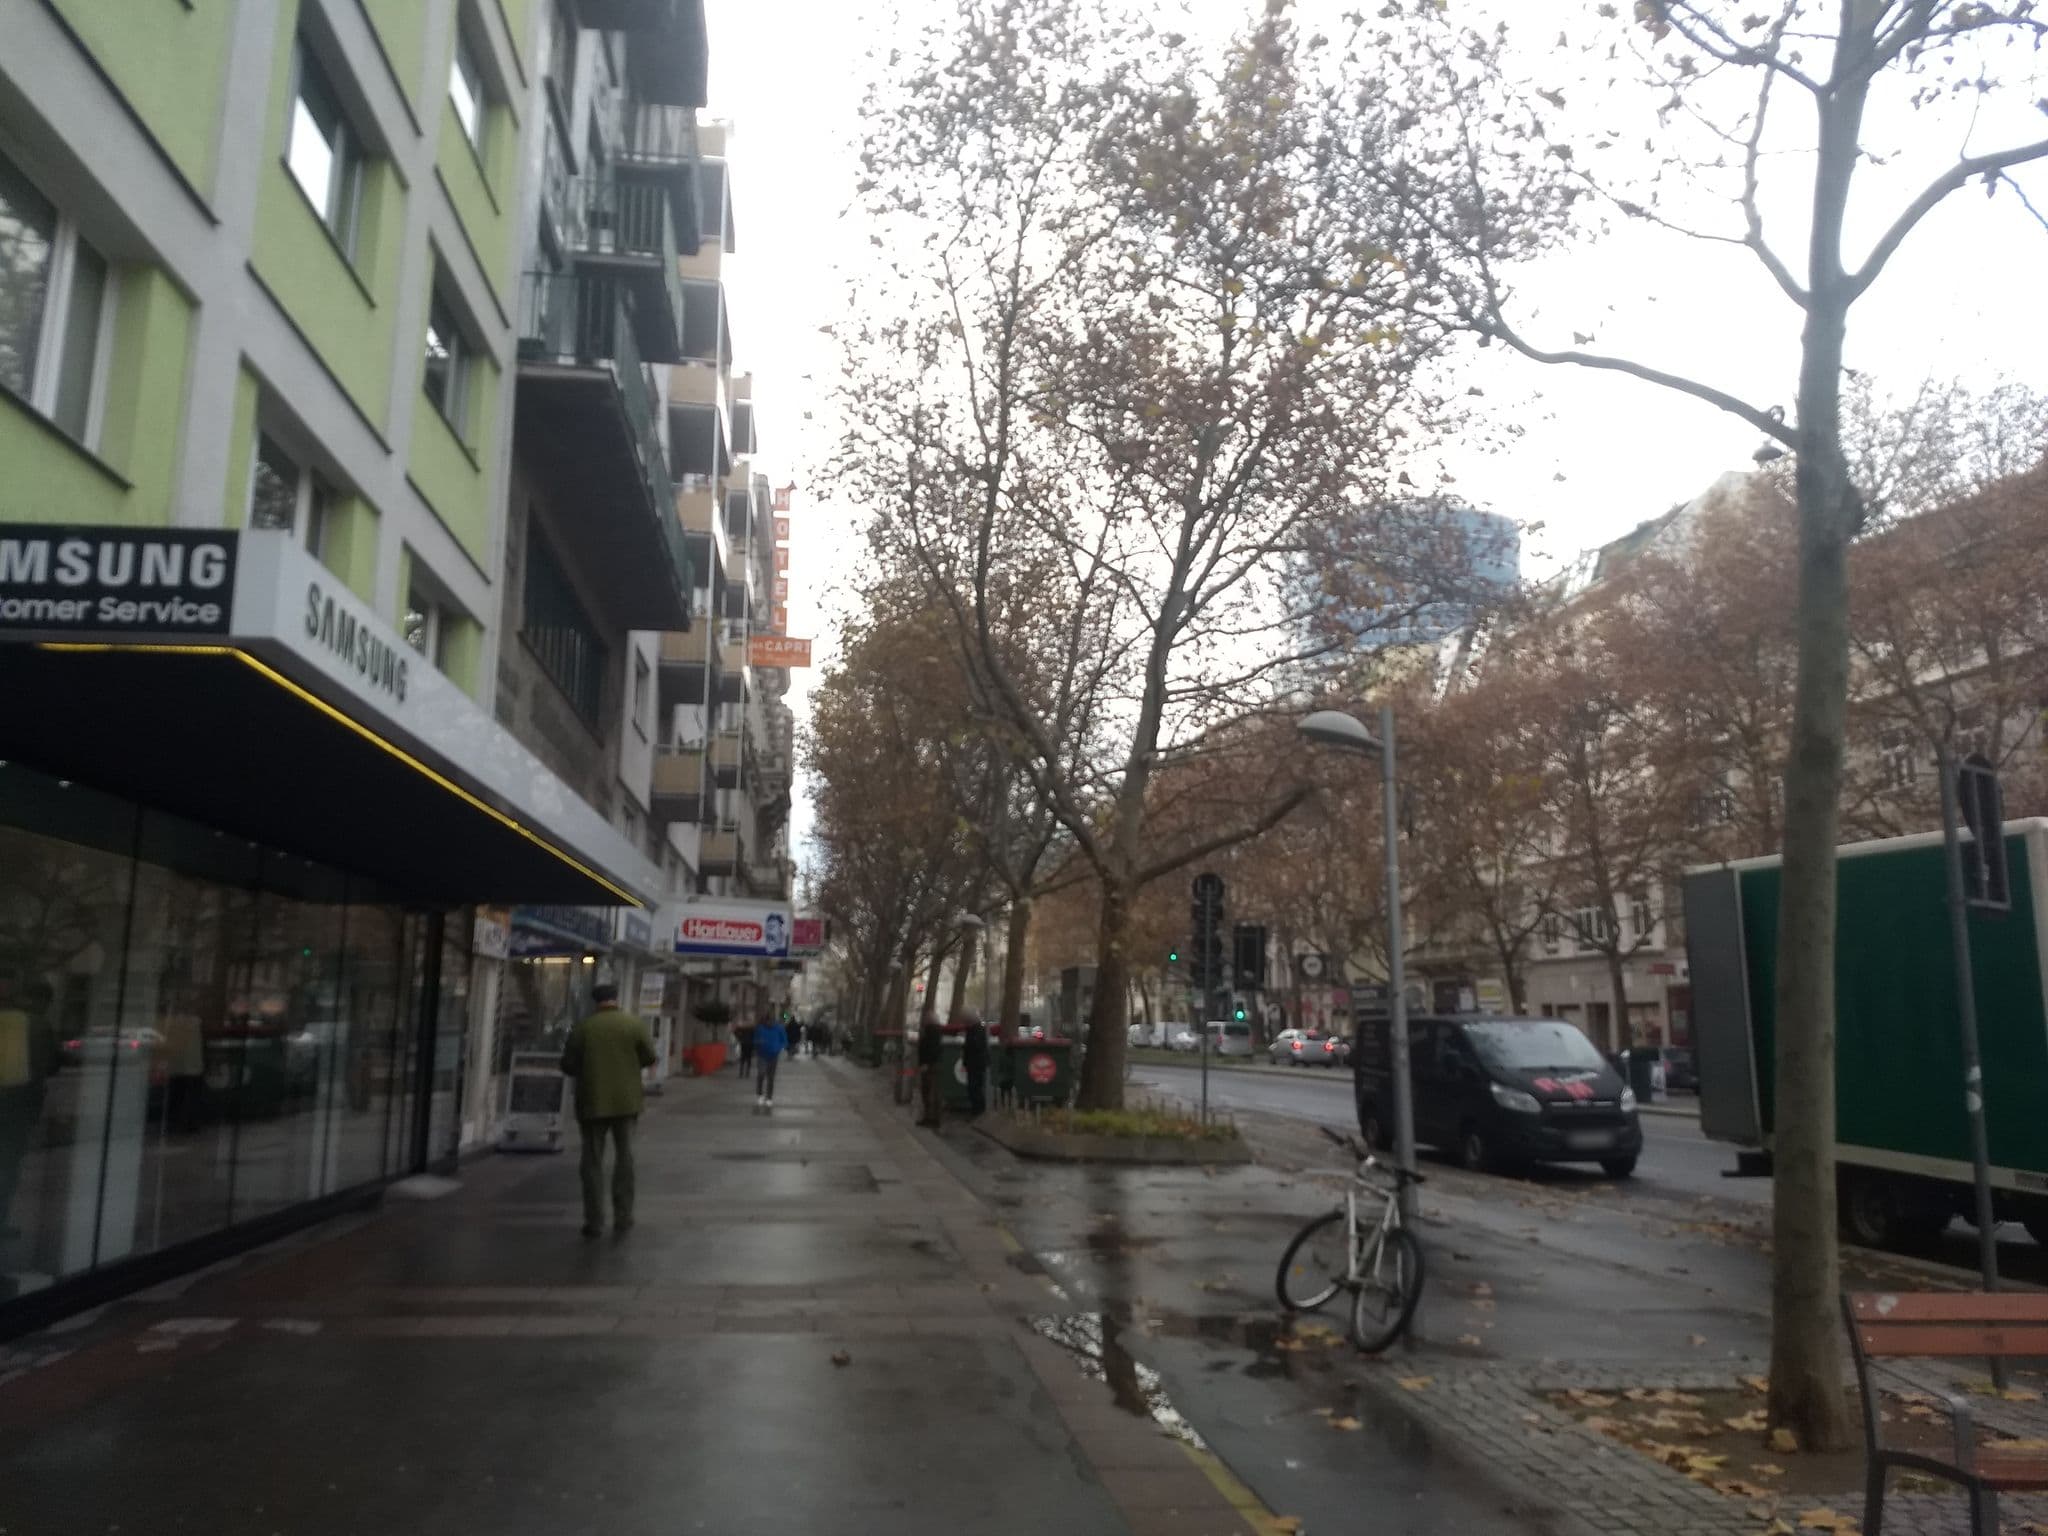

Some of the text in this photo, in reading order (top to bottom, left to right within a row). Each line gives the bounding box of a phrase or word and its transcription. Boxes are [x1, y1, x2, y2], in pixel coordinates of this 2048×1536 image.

[774, 491, 790, 626] HOTEL
[97, 596, 222, 624] Service
[305, 582, 407, 702] SAMSUNG
[764, 640, 810, 653] CAPRI
[688, 919, 759, 941] Hartlauer
